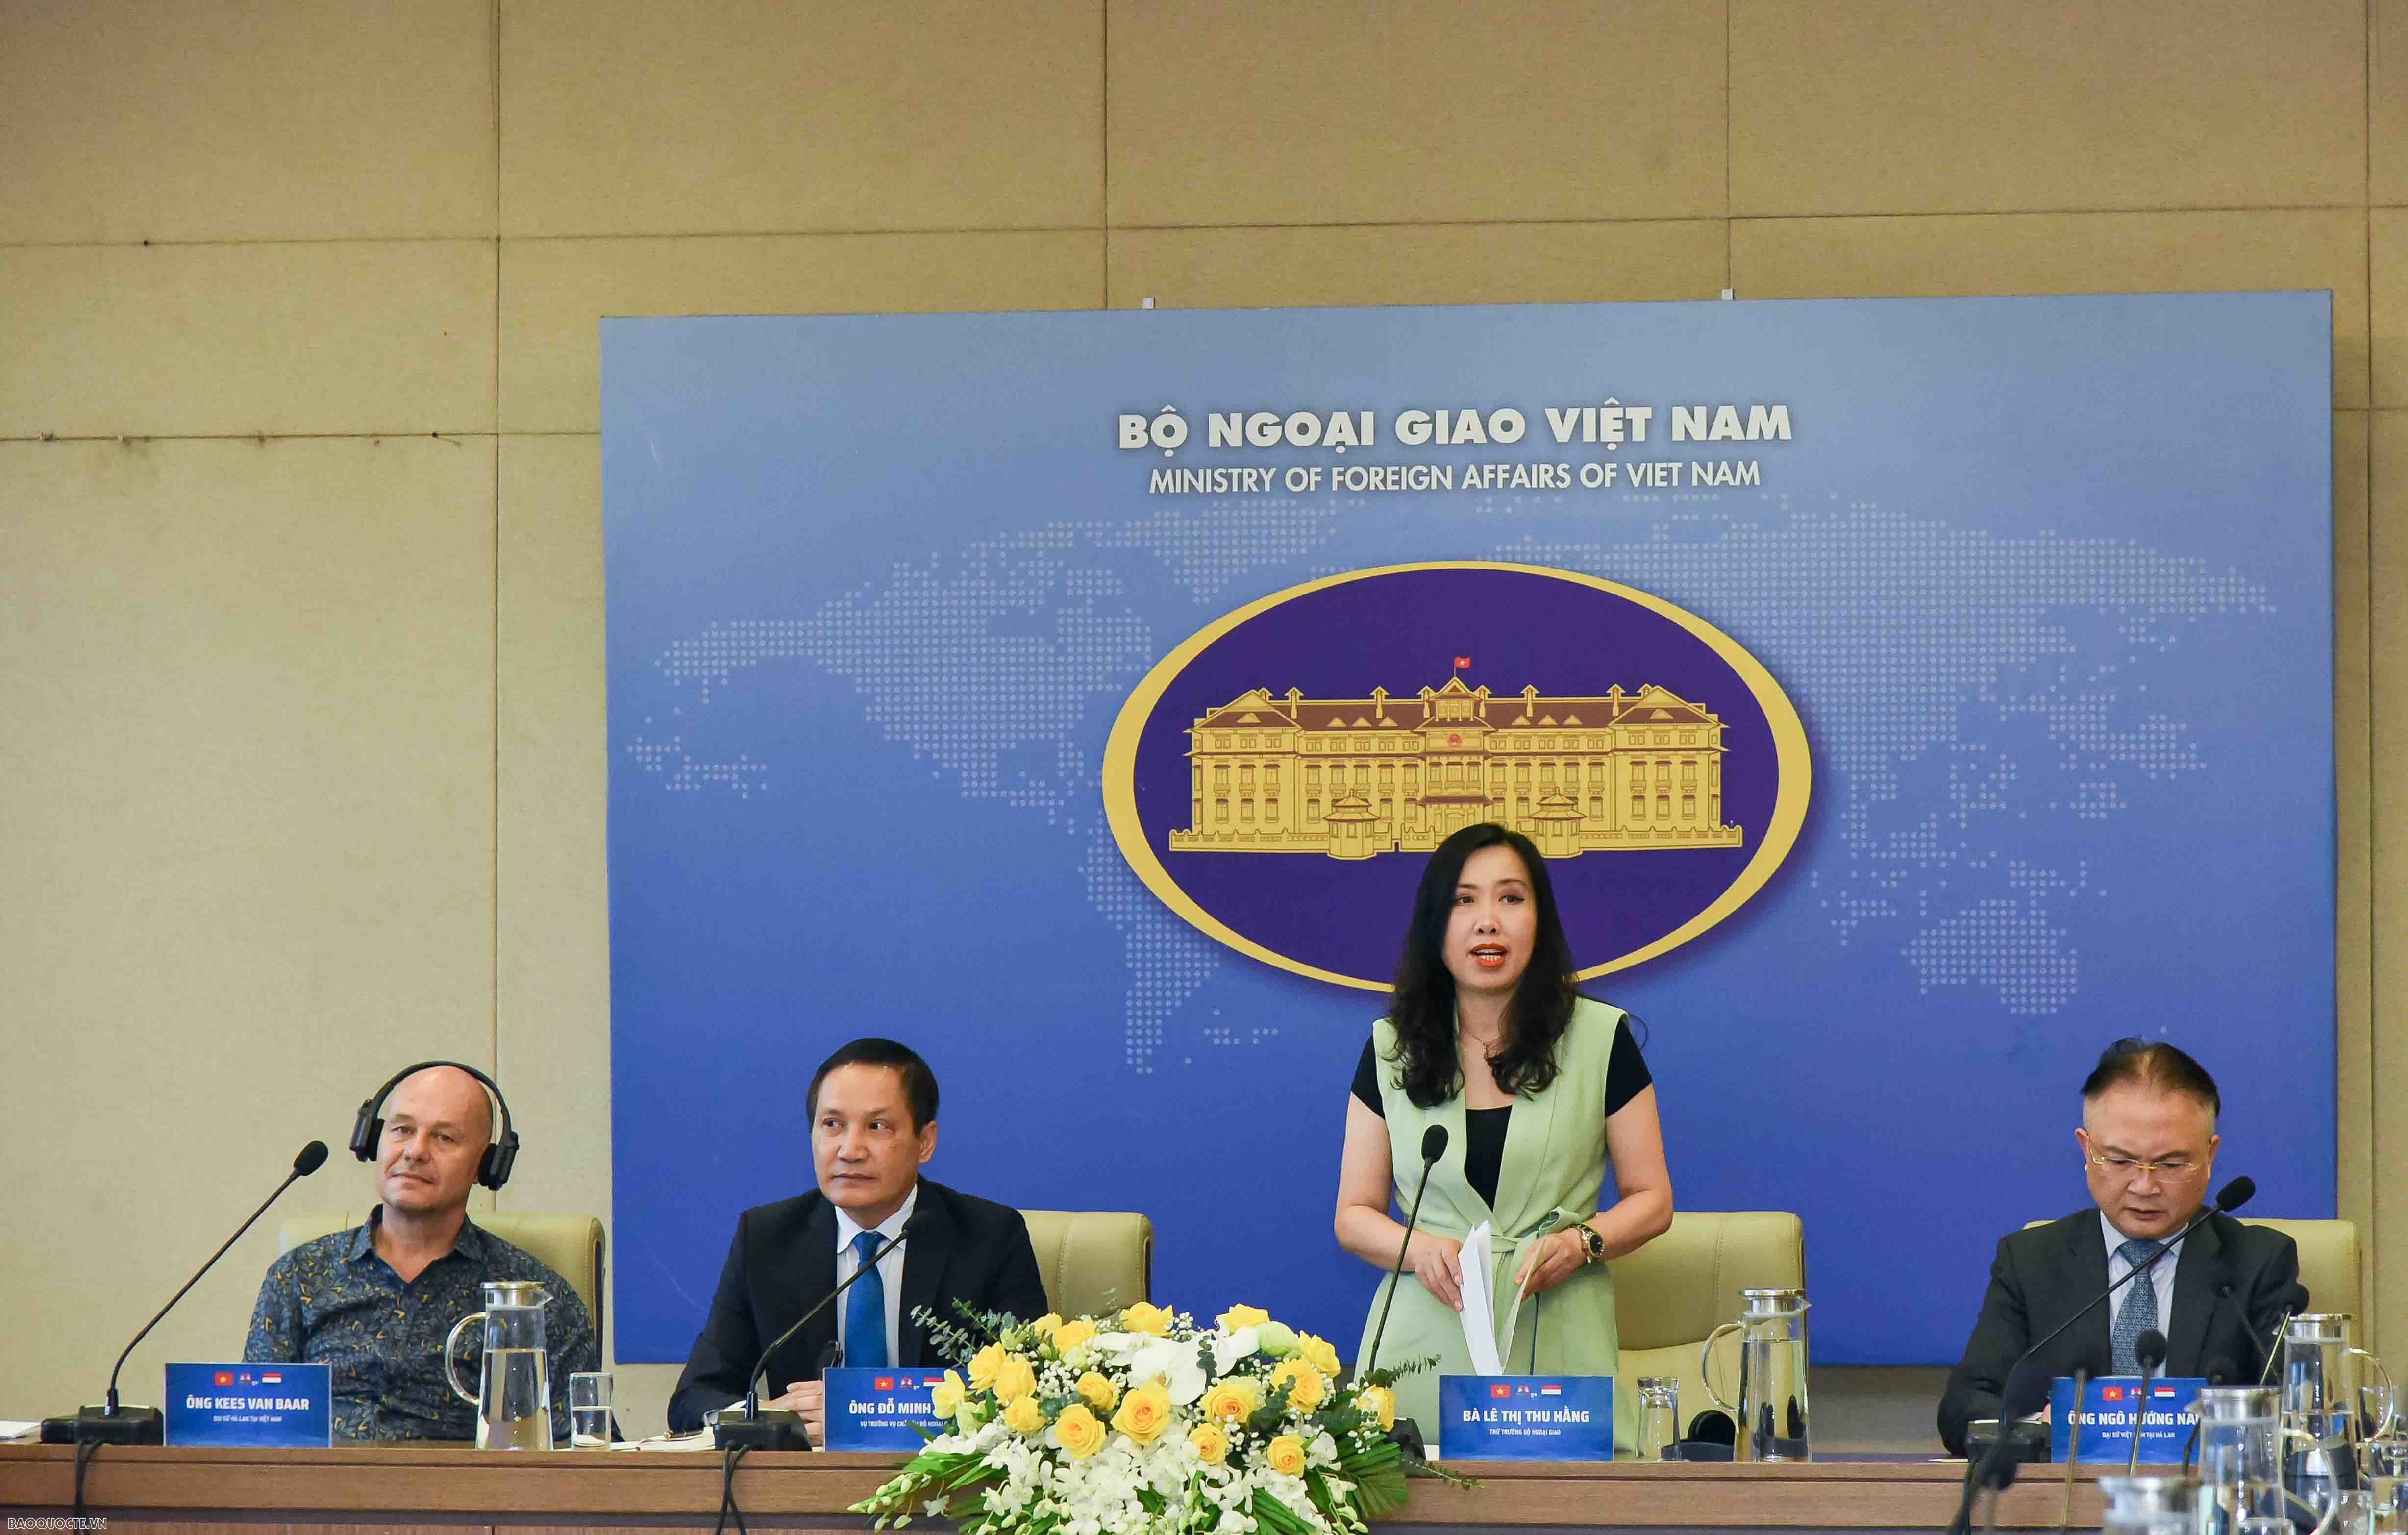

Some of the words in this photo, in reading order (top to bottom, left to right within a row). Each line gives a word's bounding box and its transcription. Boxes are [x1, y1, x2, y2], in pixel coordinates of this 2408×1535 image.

[1119, 404, 1188, 457] BỘ
[1208, 411, 1374, 454] NGOẠI
[1395, 408, 1526, 445] GIAO
[1544, 396, 1652, 451] VIỆT
[1671, 405, 1792, 442] NAM
[1149, 467, 1277, 494] MINISTRY
[1284, 466, 1322, 492] OF
[1331, 465, 1453, 491] FOREIGN
[1461, 463, 1571, 489] AFFAIRS
[1580, 462, 1618, 488] OF
[1625, 462, 1683, 487] VIET
[1691, 460, 1761, 486] NAM
[215, 1397, 245, 1410] KEES
[248, 1398, 273, 1410] VAN
[275, 1398, 310, 1410] BAAR
[848, 1400, 875, 1414] ÔNG
[877, 1397, 895, 1414] ĐỖ
[898, 1402, 931, 1414] MINH
[1463, 1407, 1480, 1422] BÀ
[1484, 1407, 1498, 1422] LÊ
[1501, 1410, 1522, 1425] THỊ
[1525, 1410, 1551, 1422] THU
[1553, 1405, 1589, 1423] HẰNG
[2068, 1411, 2095, 1425] ÔNG
[2098, 1410, 2126, 1425] NGÔ
